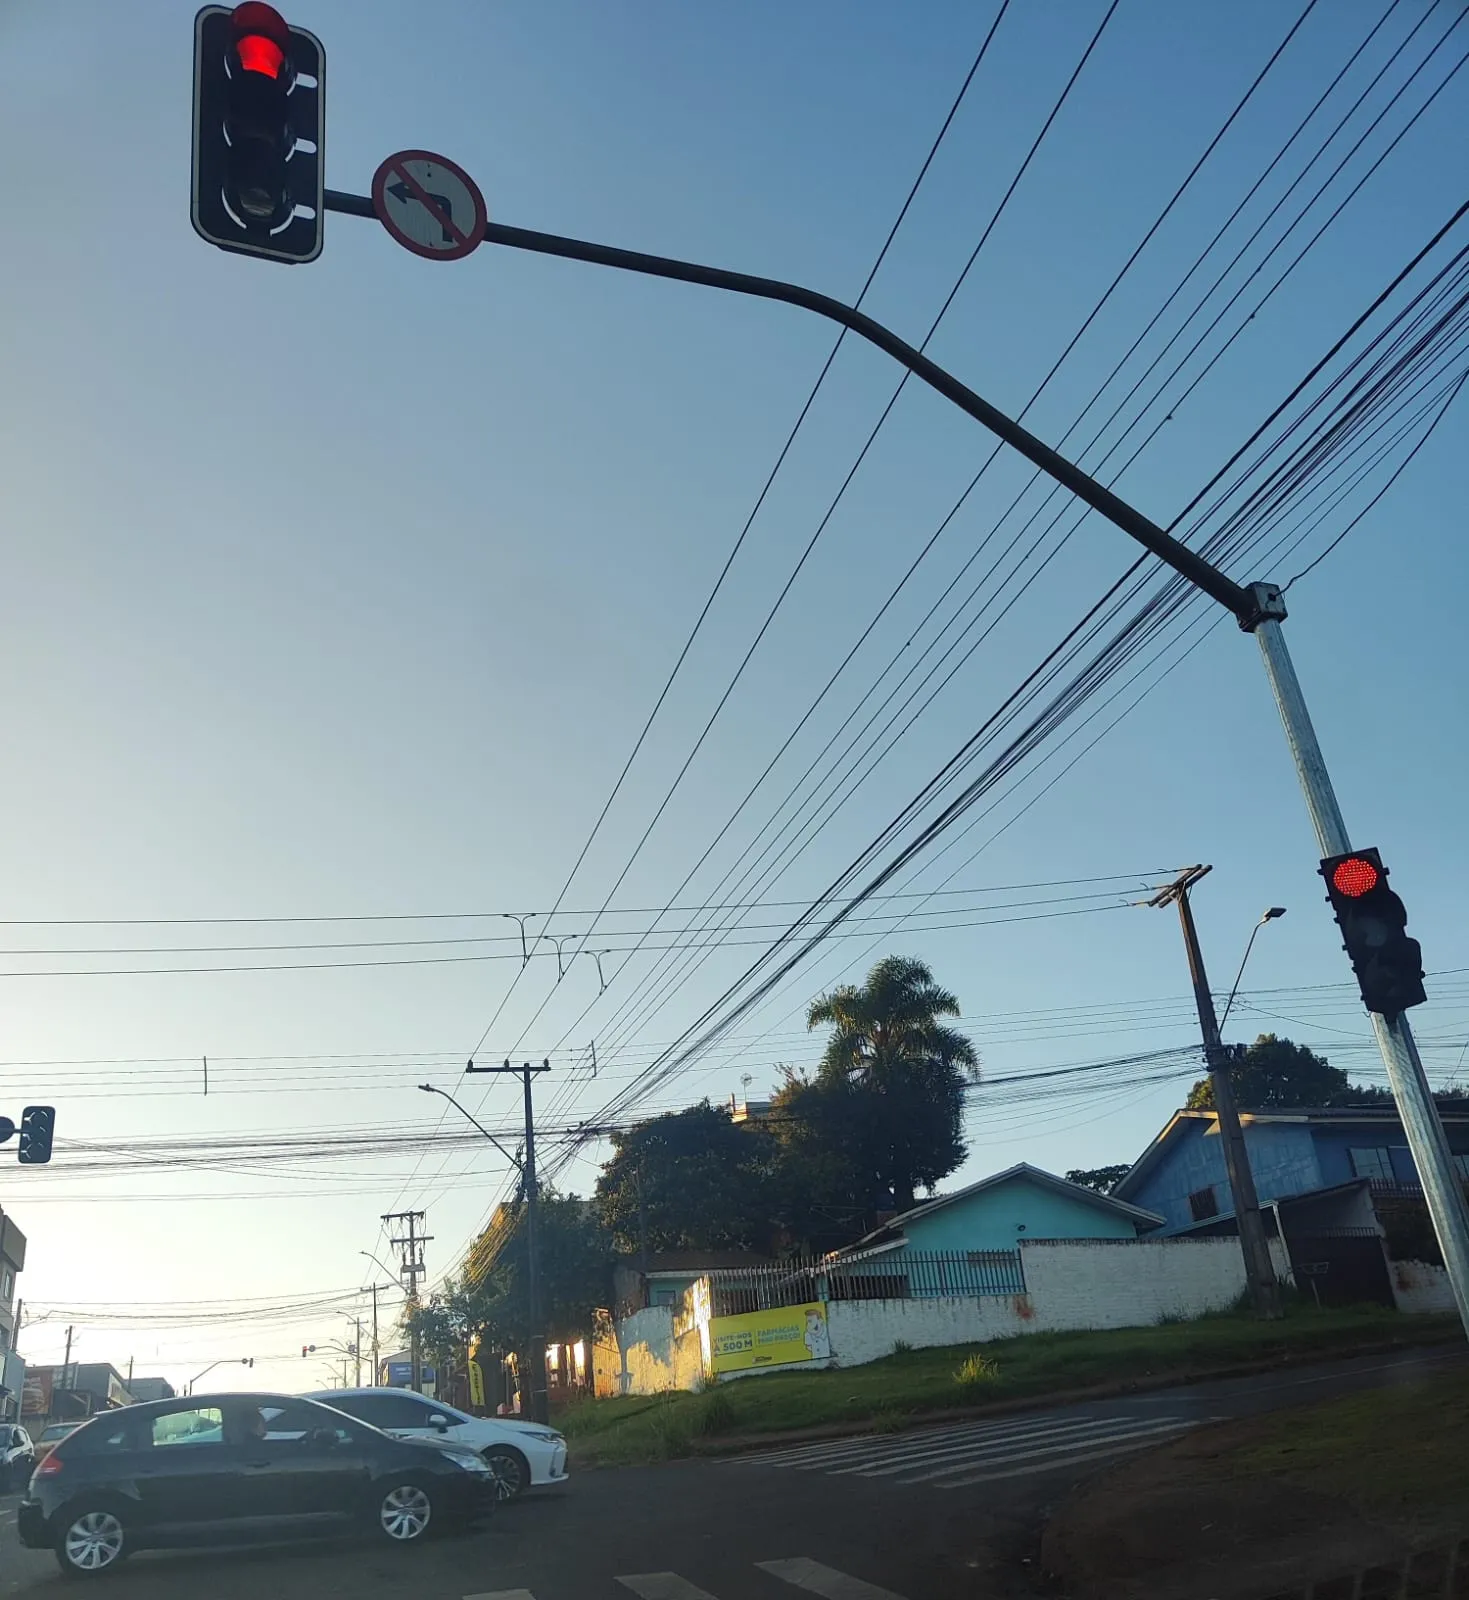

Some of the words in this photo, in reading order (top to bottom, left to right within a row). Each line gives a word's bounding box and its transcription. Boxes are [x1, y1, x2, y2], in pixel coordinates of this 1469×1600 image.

[713, 1332, 752, 1343] VISITE-NOS
[723, 1341, 743, 1352] 500
[744, 1339, 752, 1348] M
